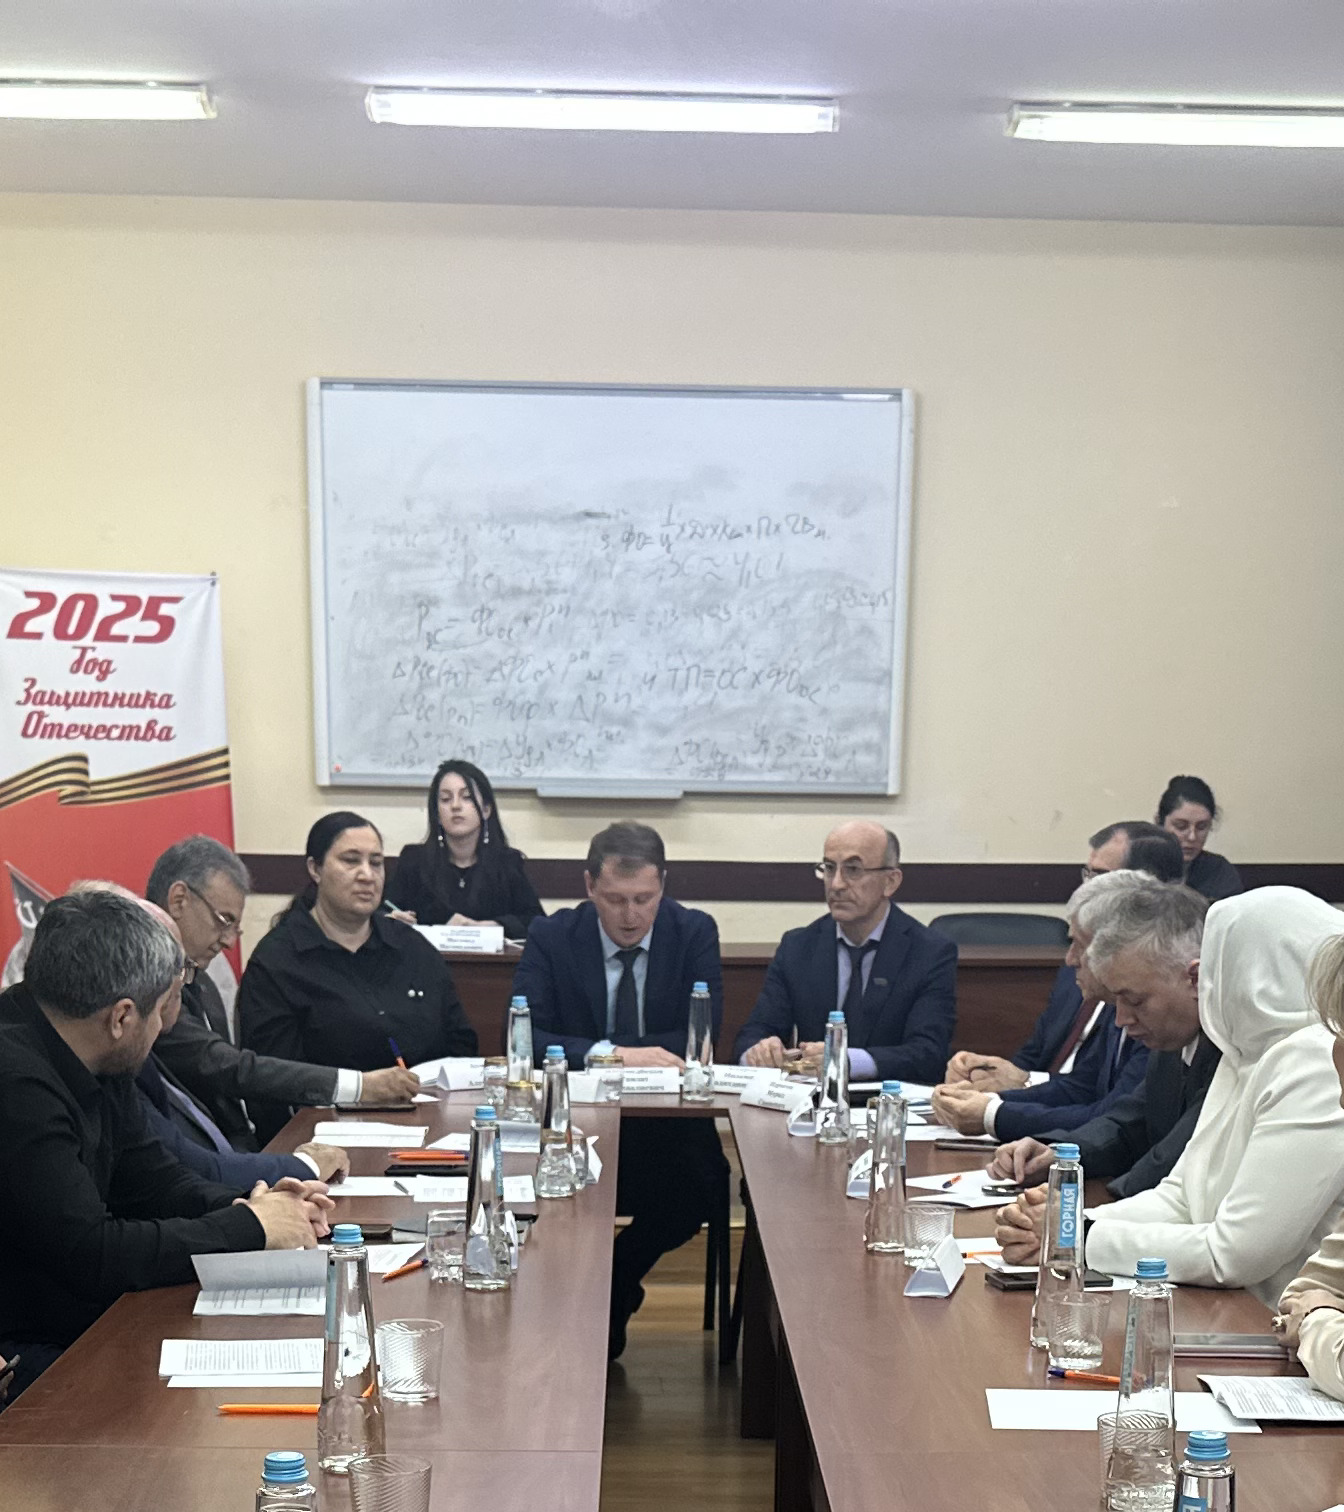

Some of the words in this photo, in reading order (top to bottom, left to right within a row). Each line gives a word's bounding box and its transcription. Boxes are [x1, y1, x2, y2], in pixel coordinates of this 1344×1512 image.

[6, 590, 186, 645] 2025
[69, 645, 117, 683] Год
[15, 676, 177, 711] Защитника
[20, 709, 177, 742] Отечества
[1061, 1187, 1077, 1239] ГОРНАЯ
